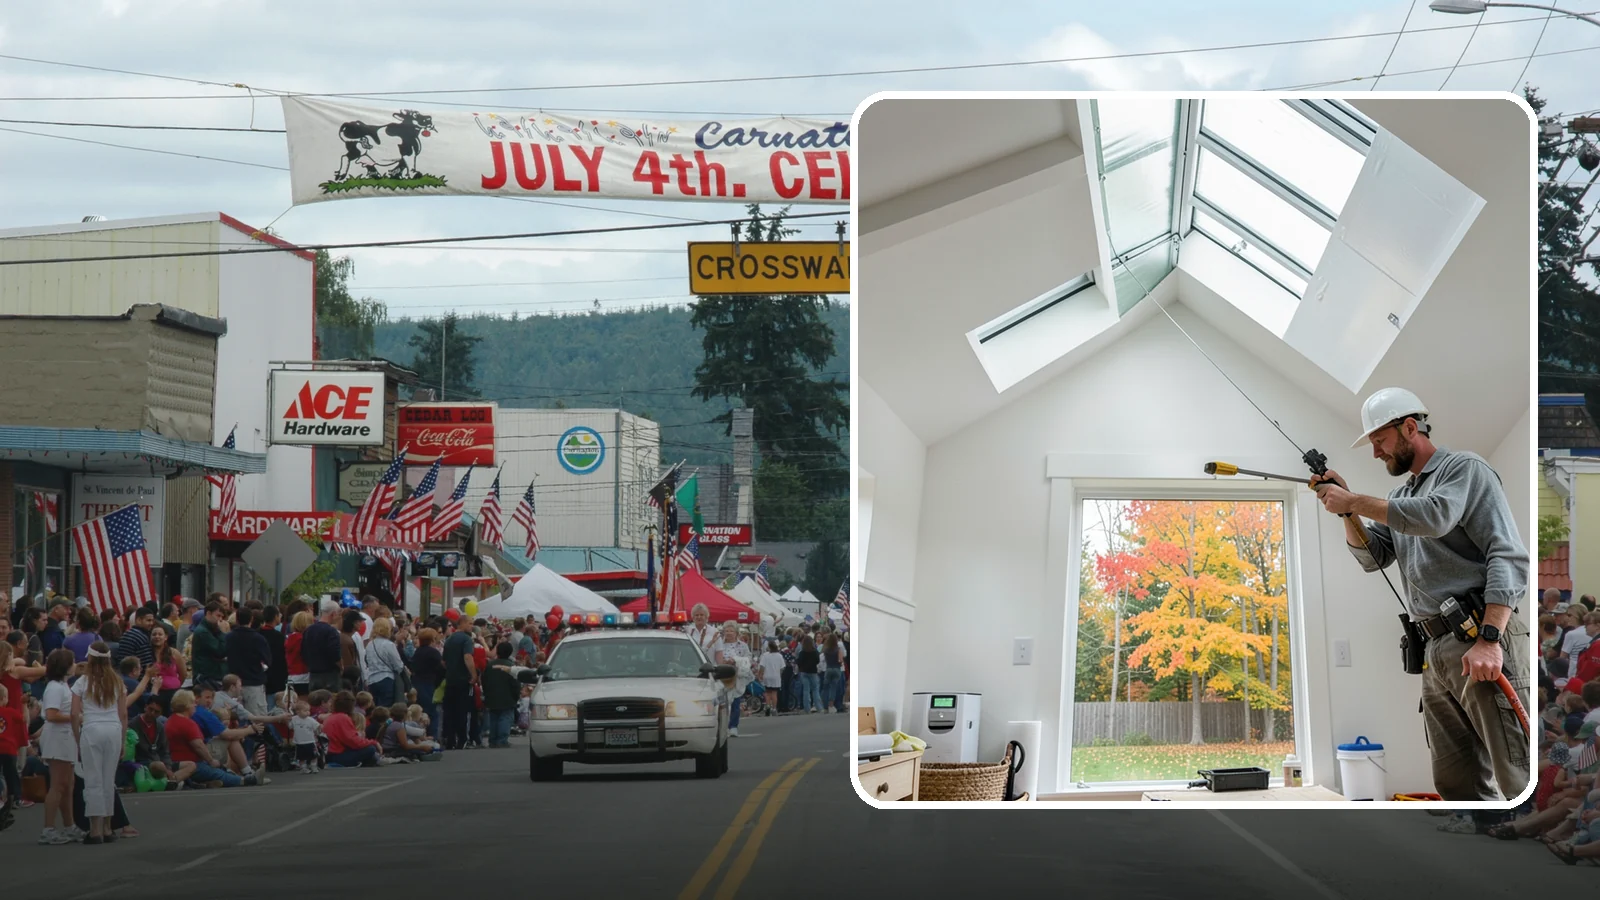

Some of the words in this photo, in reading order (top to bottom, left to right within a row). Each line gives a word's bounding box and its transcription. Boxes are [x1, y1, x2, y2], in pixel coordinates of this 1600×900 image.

[695, 121, 850, 150] Carnat
[481, 141, 605, 193] JULY
[632, 150, 746, 197] 4th.
[697, 254, 850, 280] CROSSWA
[283, 380, 374, 420] ACE
[406, 409, 453, 421] CEDAR
[283, 421, 371, 437] Hardware
[416, 428, 477, 446] Coca-Cola
[83, 485, 93, 494] St.
[95, 485, 124, 494] Vincent
[126, 485, 135, 494] de
[137, 486, 155, 495] Paul
[688, 526, 741, 535] CRNATION
[699, 535, 730, 543] GLASS
